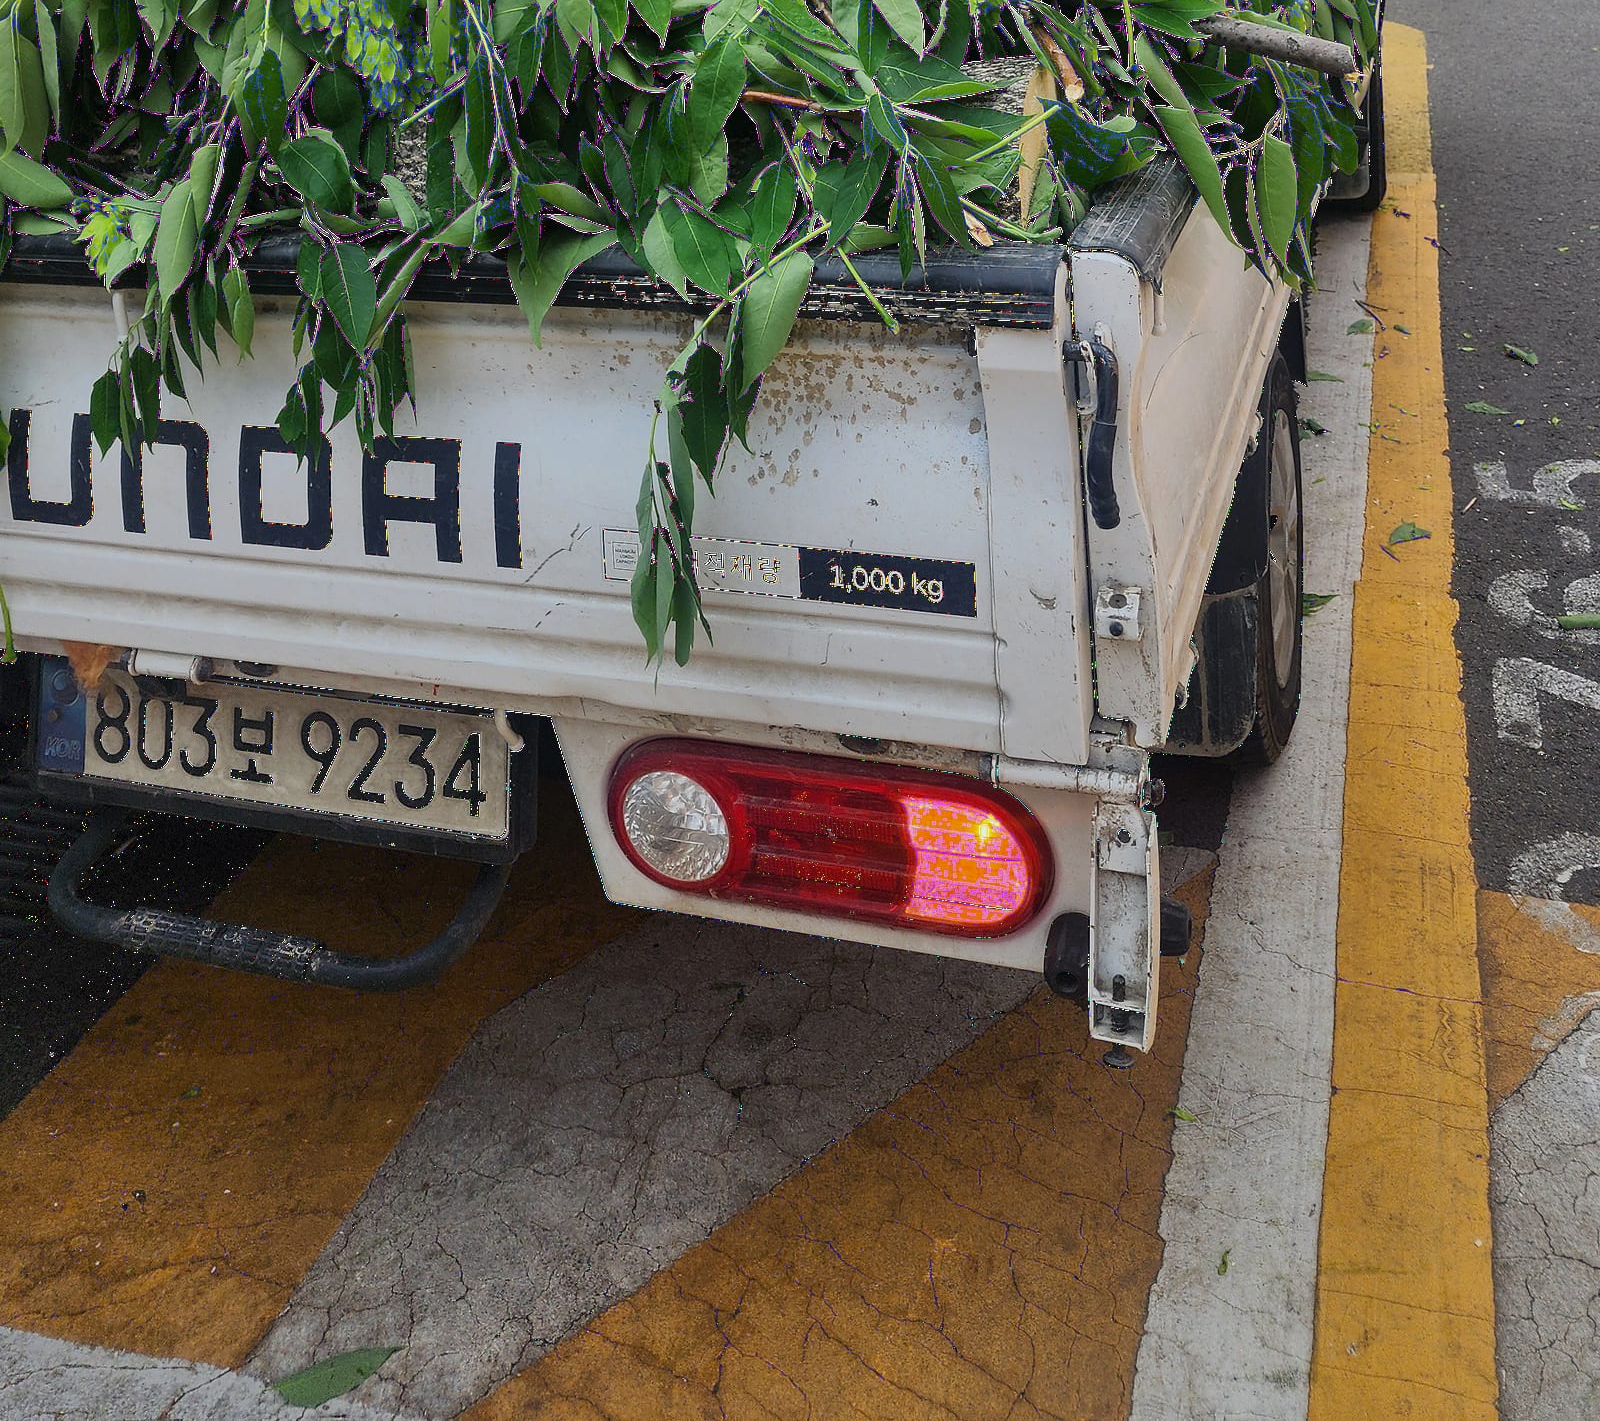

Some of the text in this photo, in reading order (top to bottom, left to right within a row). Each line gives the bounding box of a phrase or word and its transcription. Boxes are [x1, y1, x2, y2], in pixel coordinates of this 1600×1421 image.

[829, 565, 906, 594] 1,000
[911, 571, 945, 604] kg
[44, 736, 81, 762] KOR
[301, 710, 488, 818] 9234
